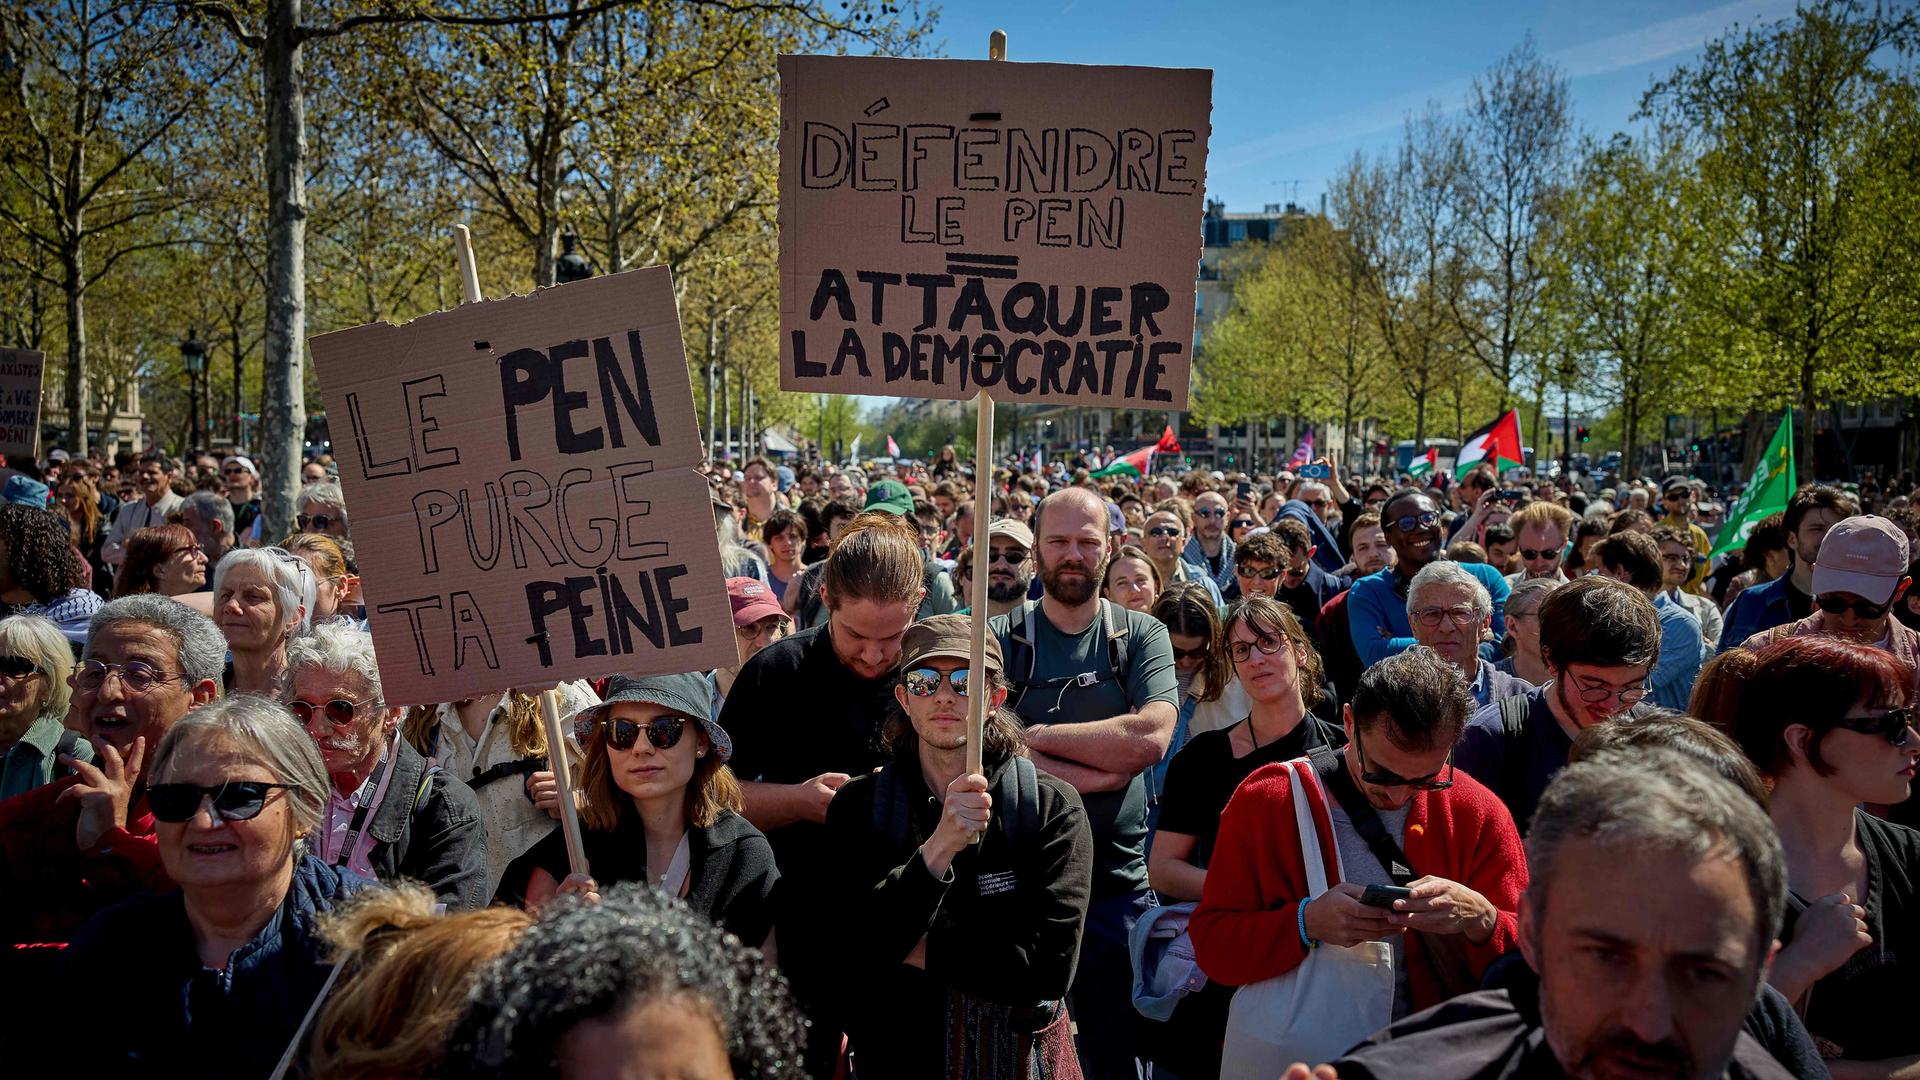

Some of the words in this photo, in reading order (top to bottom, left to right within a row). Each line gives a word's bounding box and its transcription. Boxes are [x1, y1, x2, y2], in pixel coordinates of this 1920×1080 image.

[900, 195, 966, 245] LE
[1004, 197, 1124, 249] PEN
[809, 268, 1170, 337] ATTAQUER
[791, 327, 872, 378] LA
[345, 374, 460, 480] LE
[497, 328, 661, 461] PEN
[411, 460, 669, 575] PURGE
[377, 590, 499, 677] TA
